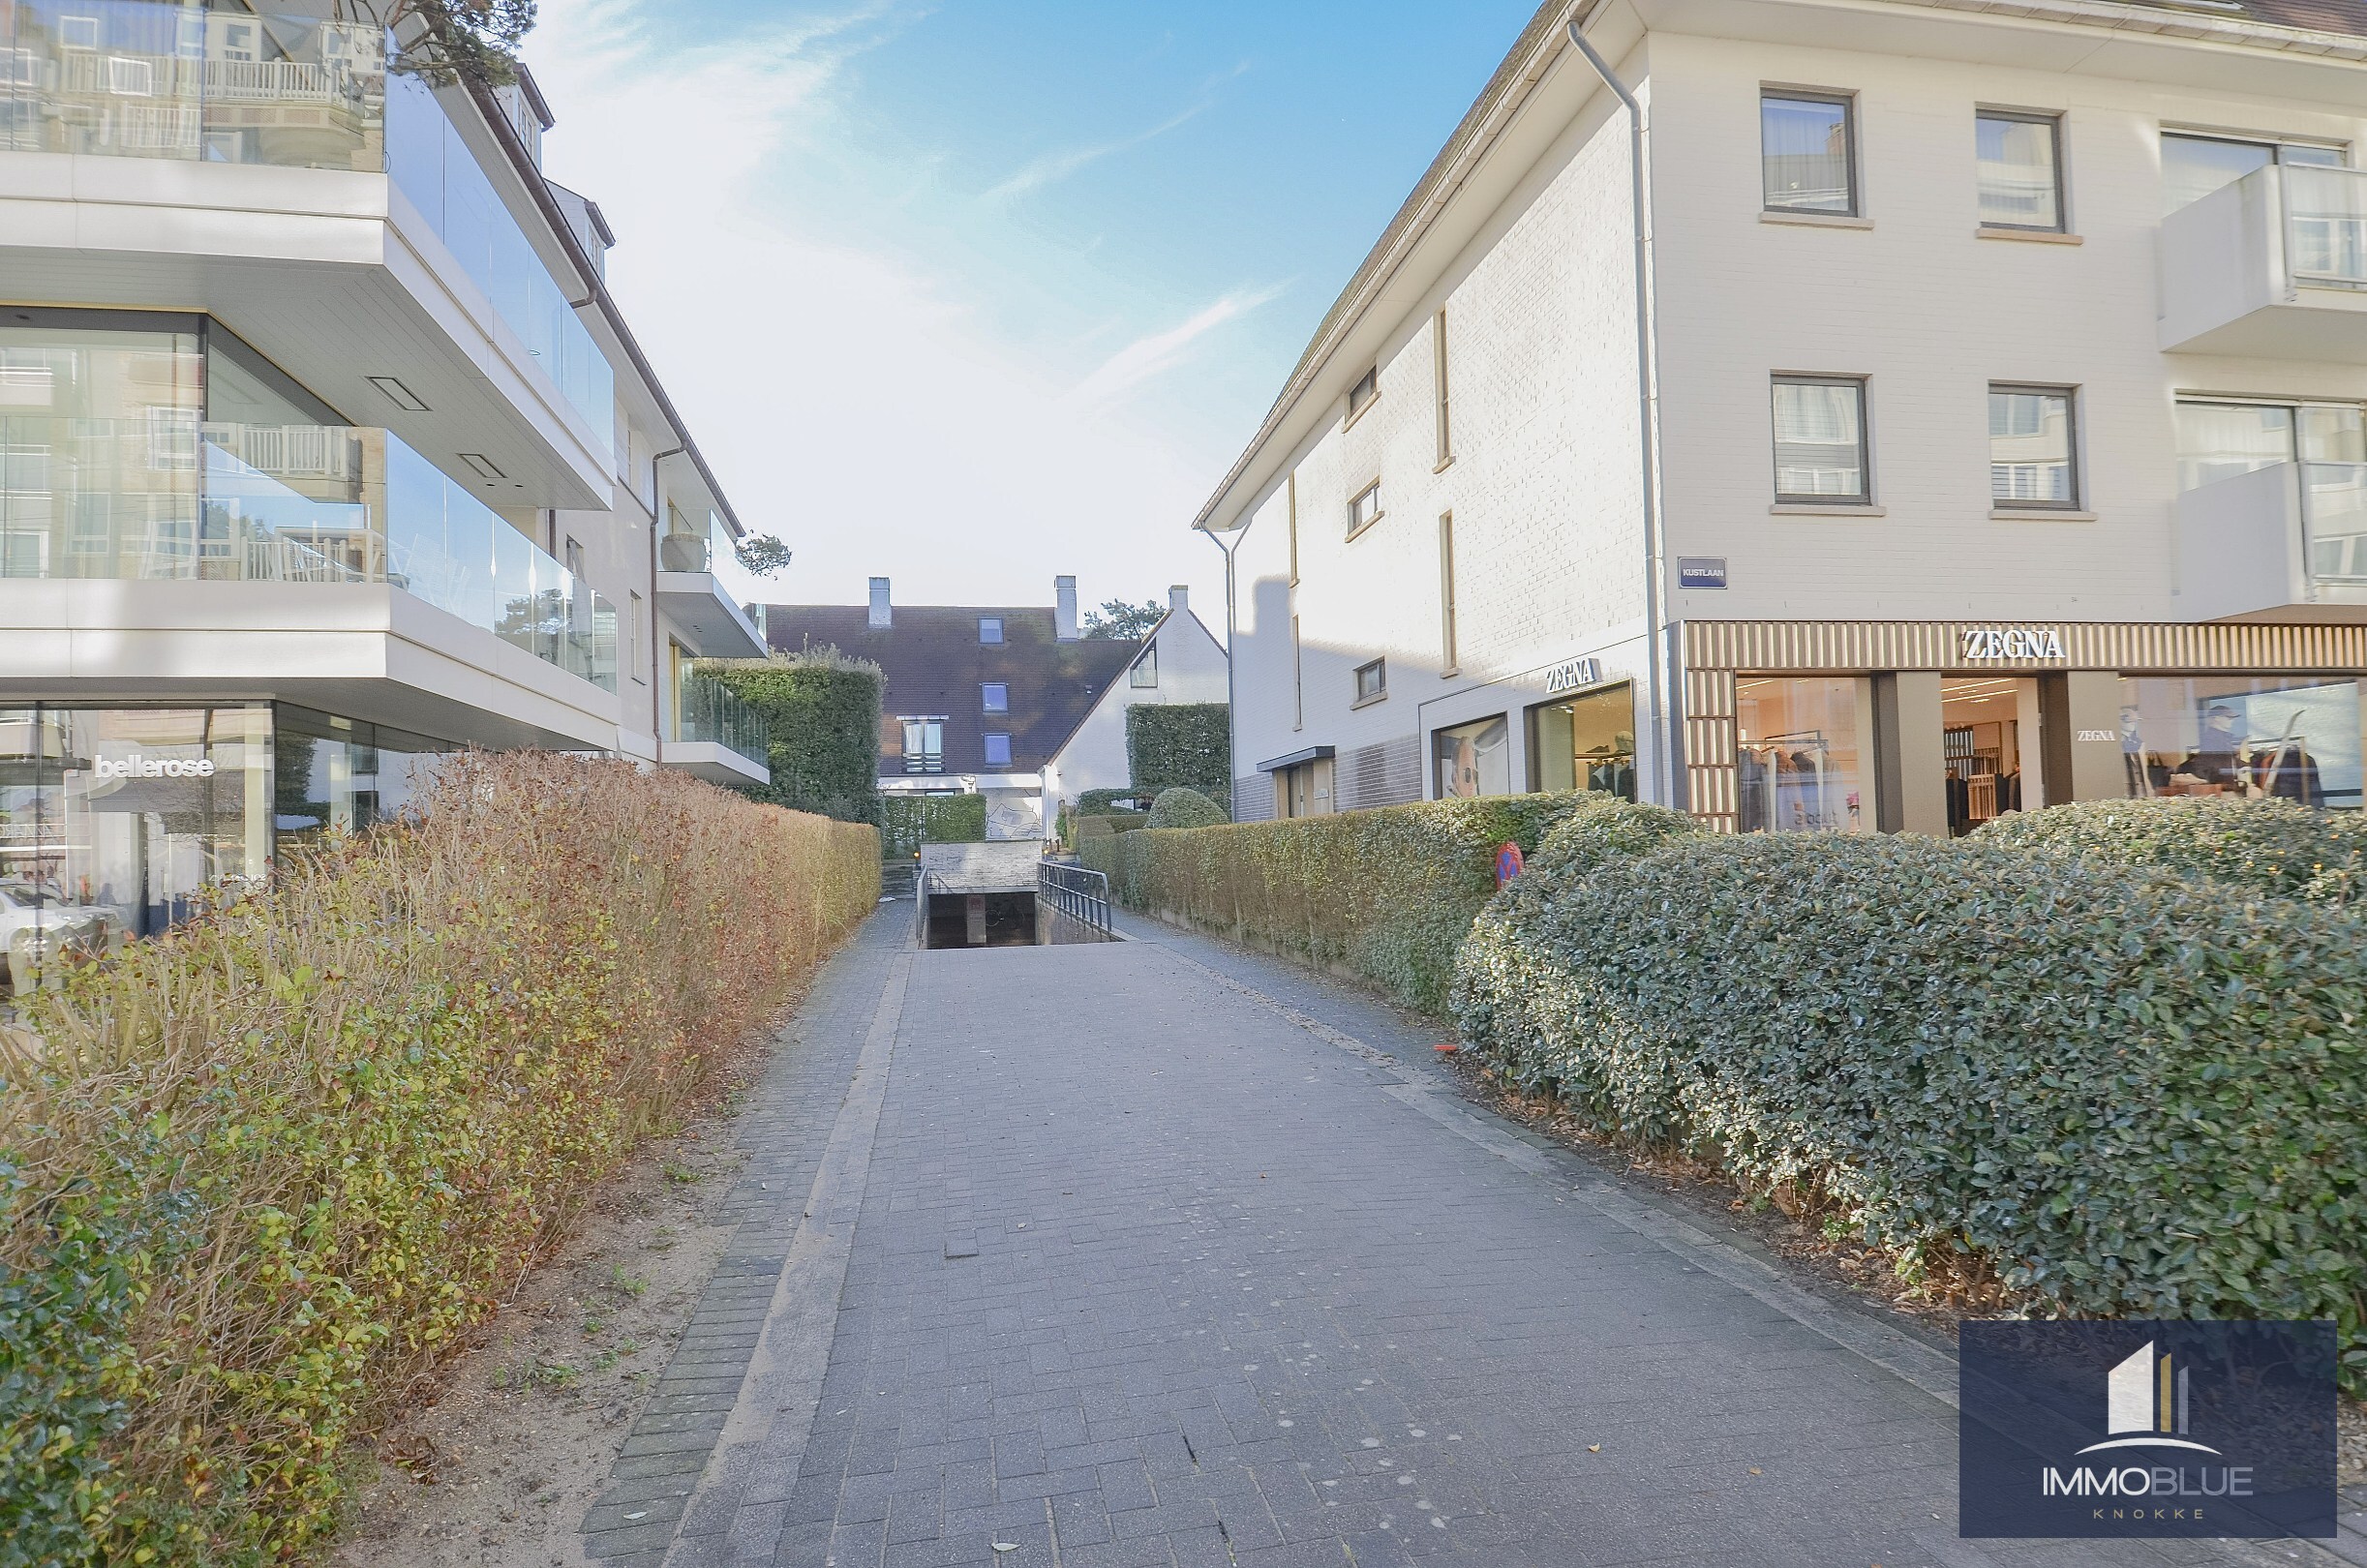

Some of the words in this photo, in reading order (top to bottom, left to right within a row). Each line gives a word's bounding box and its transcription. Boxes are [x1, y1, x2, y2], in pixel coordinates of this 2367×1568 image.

[1683, 568, 1724, 577] KUSTLAAN
[1964, 629, 2066, 658] ZEGNA
[1545, 658, 1595, 694] ZEGNA
[2077, 730, 2116, 741] ZEGNA
[95, 754, 214, 778] bellerose
